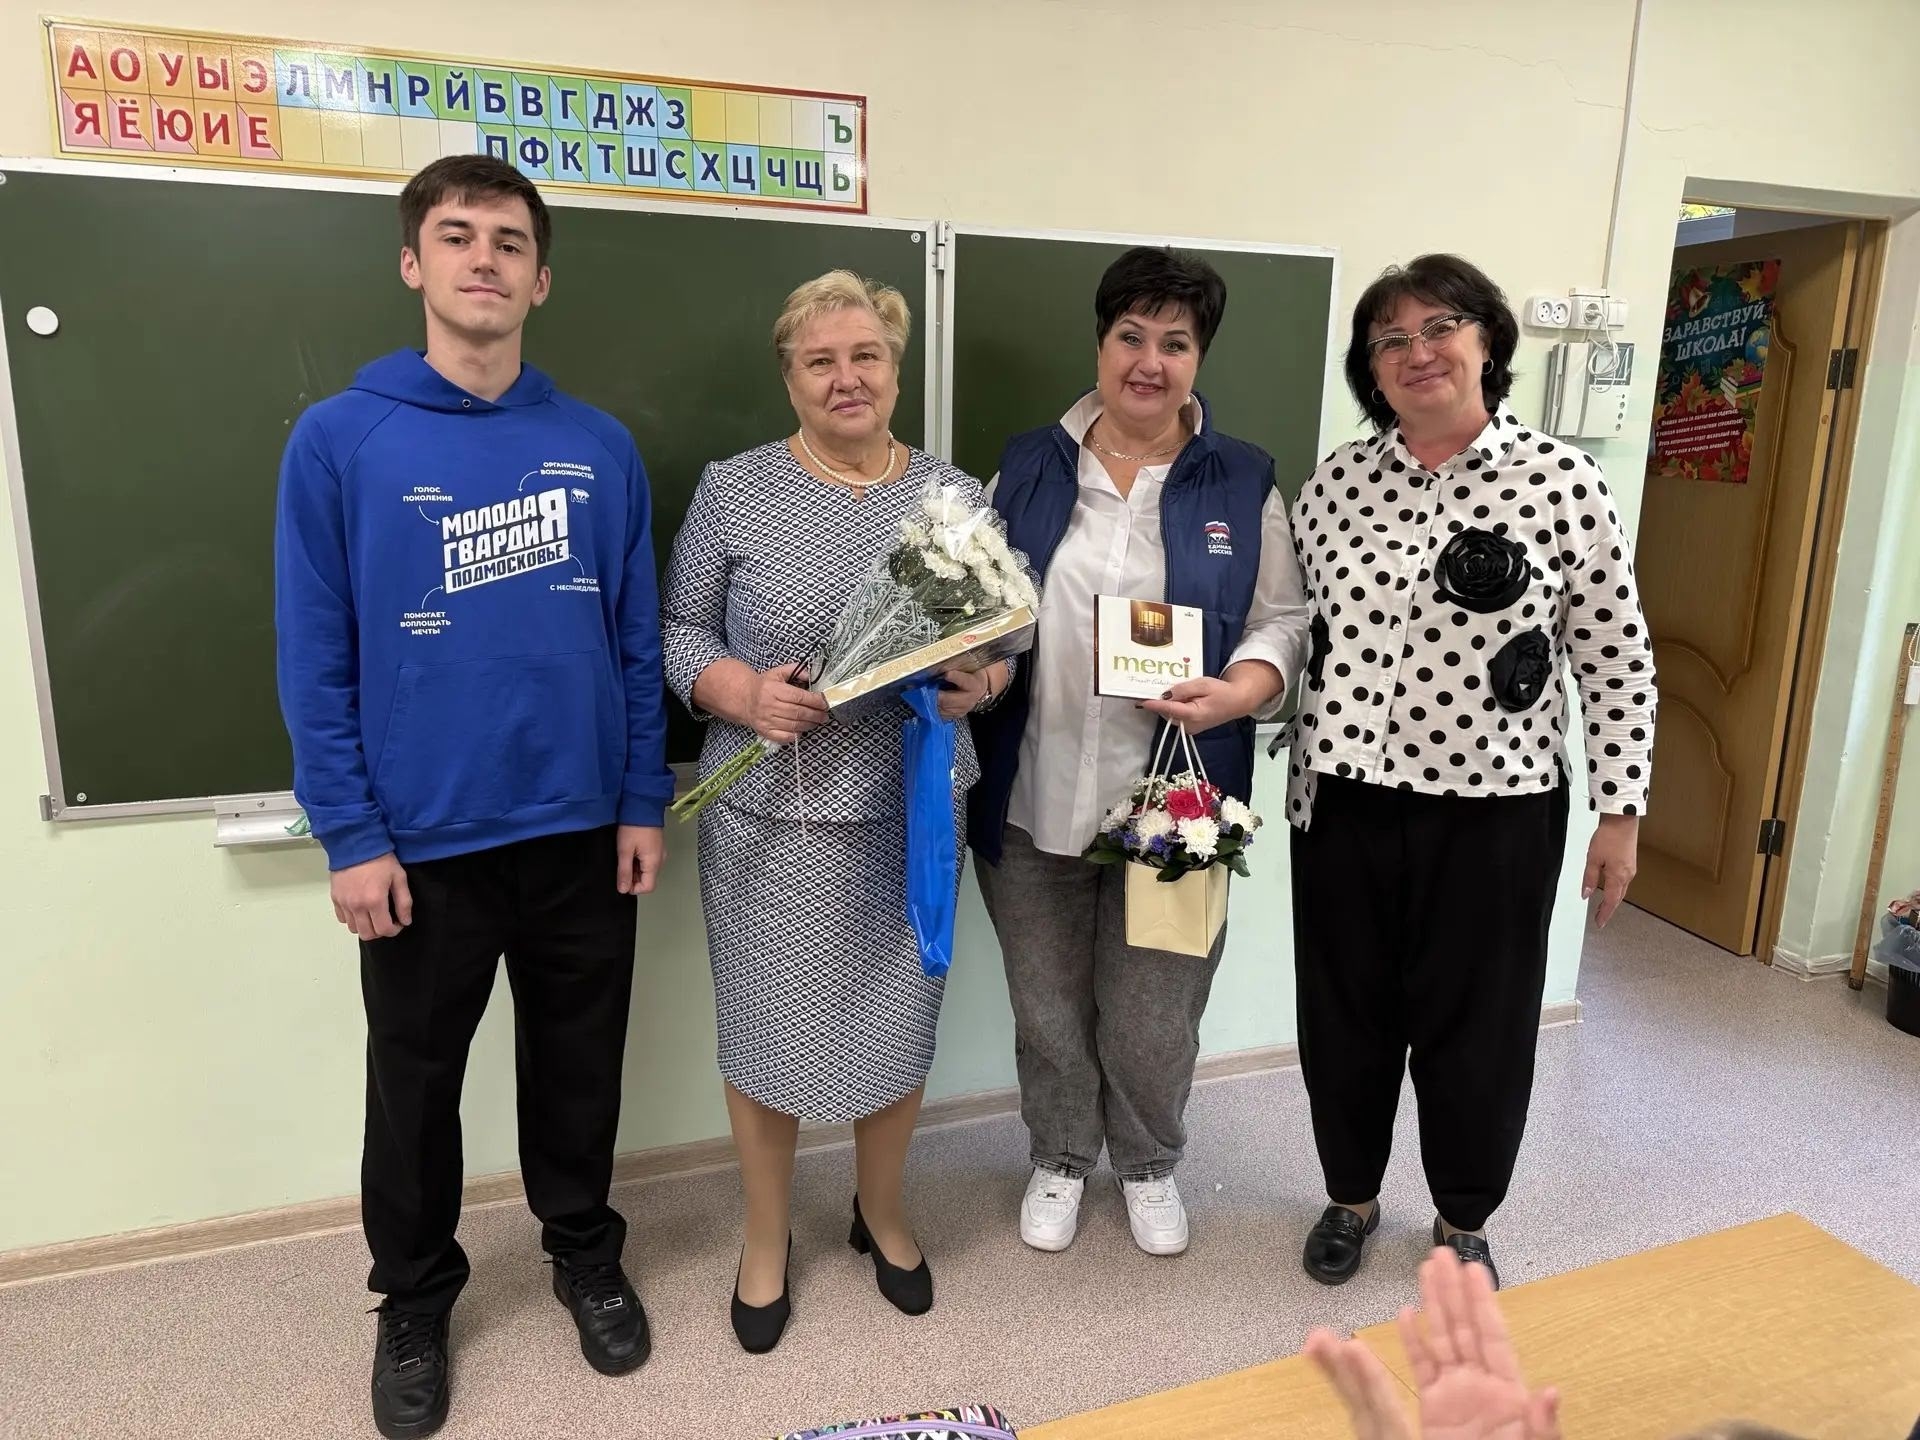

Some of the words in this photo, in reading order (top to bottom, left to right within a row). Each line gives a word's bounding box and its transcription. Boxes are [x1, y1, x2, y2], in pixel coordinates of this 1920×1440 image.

[67, 45, 98, 80] А
[110, 48, 140, 82] О
[159, 52, 184, 87] У
[198, 57, 229, 91] Ы
[243, 59, 267, 93] Э
[286, 63, 310, 97] Л
[325, 68, 354, 101] М
[368, 71, 392, 104] Н
[410, 75, 430, 107] Р
[446, 71, 470, 110] Й
[484, 82, 507, 114] Б
[521, 86, 544, 117] В
[561, 89, 578, 120] Г
[593, 93, 618, 130] Д
[626, 95, 655, 127] Ж
[666, 99, 685, 130] З
[828, 114, 852, 145] Ъ
[74, 103, 100, 136] Я
[119, 99, 142, 139] Ё
[157, 109, 193, 142] Ю
[204, 112, 229, 145] И
[249, 117, 271, 148] Е
[485, 135, 508, 161] П
[519, 136, 549, 168] Ф
[562, 141, 583, 171] К
[597, 143, 616, 174] Т
[627, 146, 657, 177] Ш
[665, 149, 686, 180] С
[700, 152, 721, 183] Х
[733, 155, 755, 189] Ц
[767, 158, 786, 187] Ч
[795, 161, 823, 195] Щ
[833, 164, 850, 192] Ь
[1663, 301, 1768, 343] ЗДРАВСТВУЙ,
[1675, 327, 1747, 362] ШКОЛА!
[540, 468, 595, 480] ВОЗМОЖНОСТЕЙ
[543, 461, 592, 472] ОРГАНИЗАЦИЯ
[402, 494, 453, 502] ПОКОЛЕНИЯ
[452, 543, 564, 589] ПОДМОСКОВЬЕ
[400, 619, 451, 628] ВОПЛОЩАТЬ
[404, 611, 446, 619] ПОМОГАЕТ
[1113, 655, 1190, 678] merci
